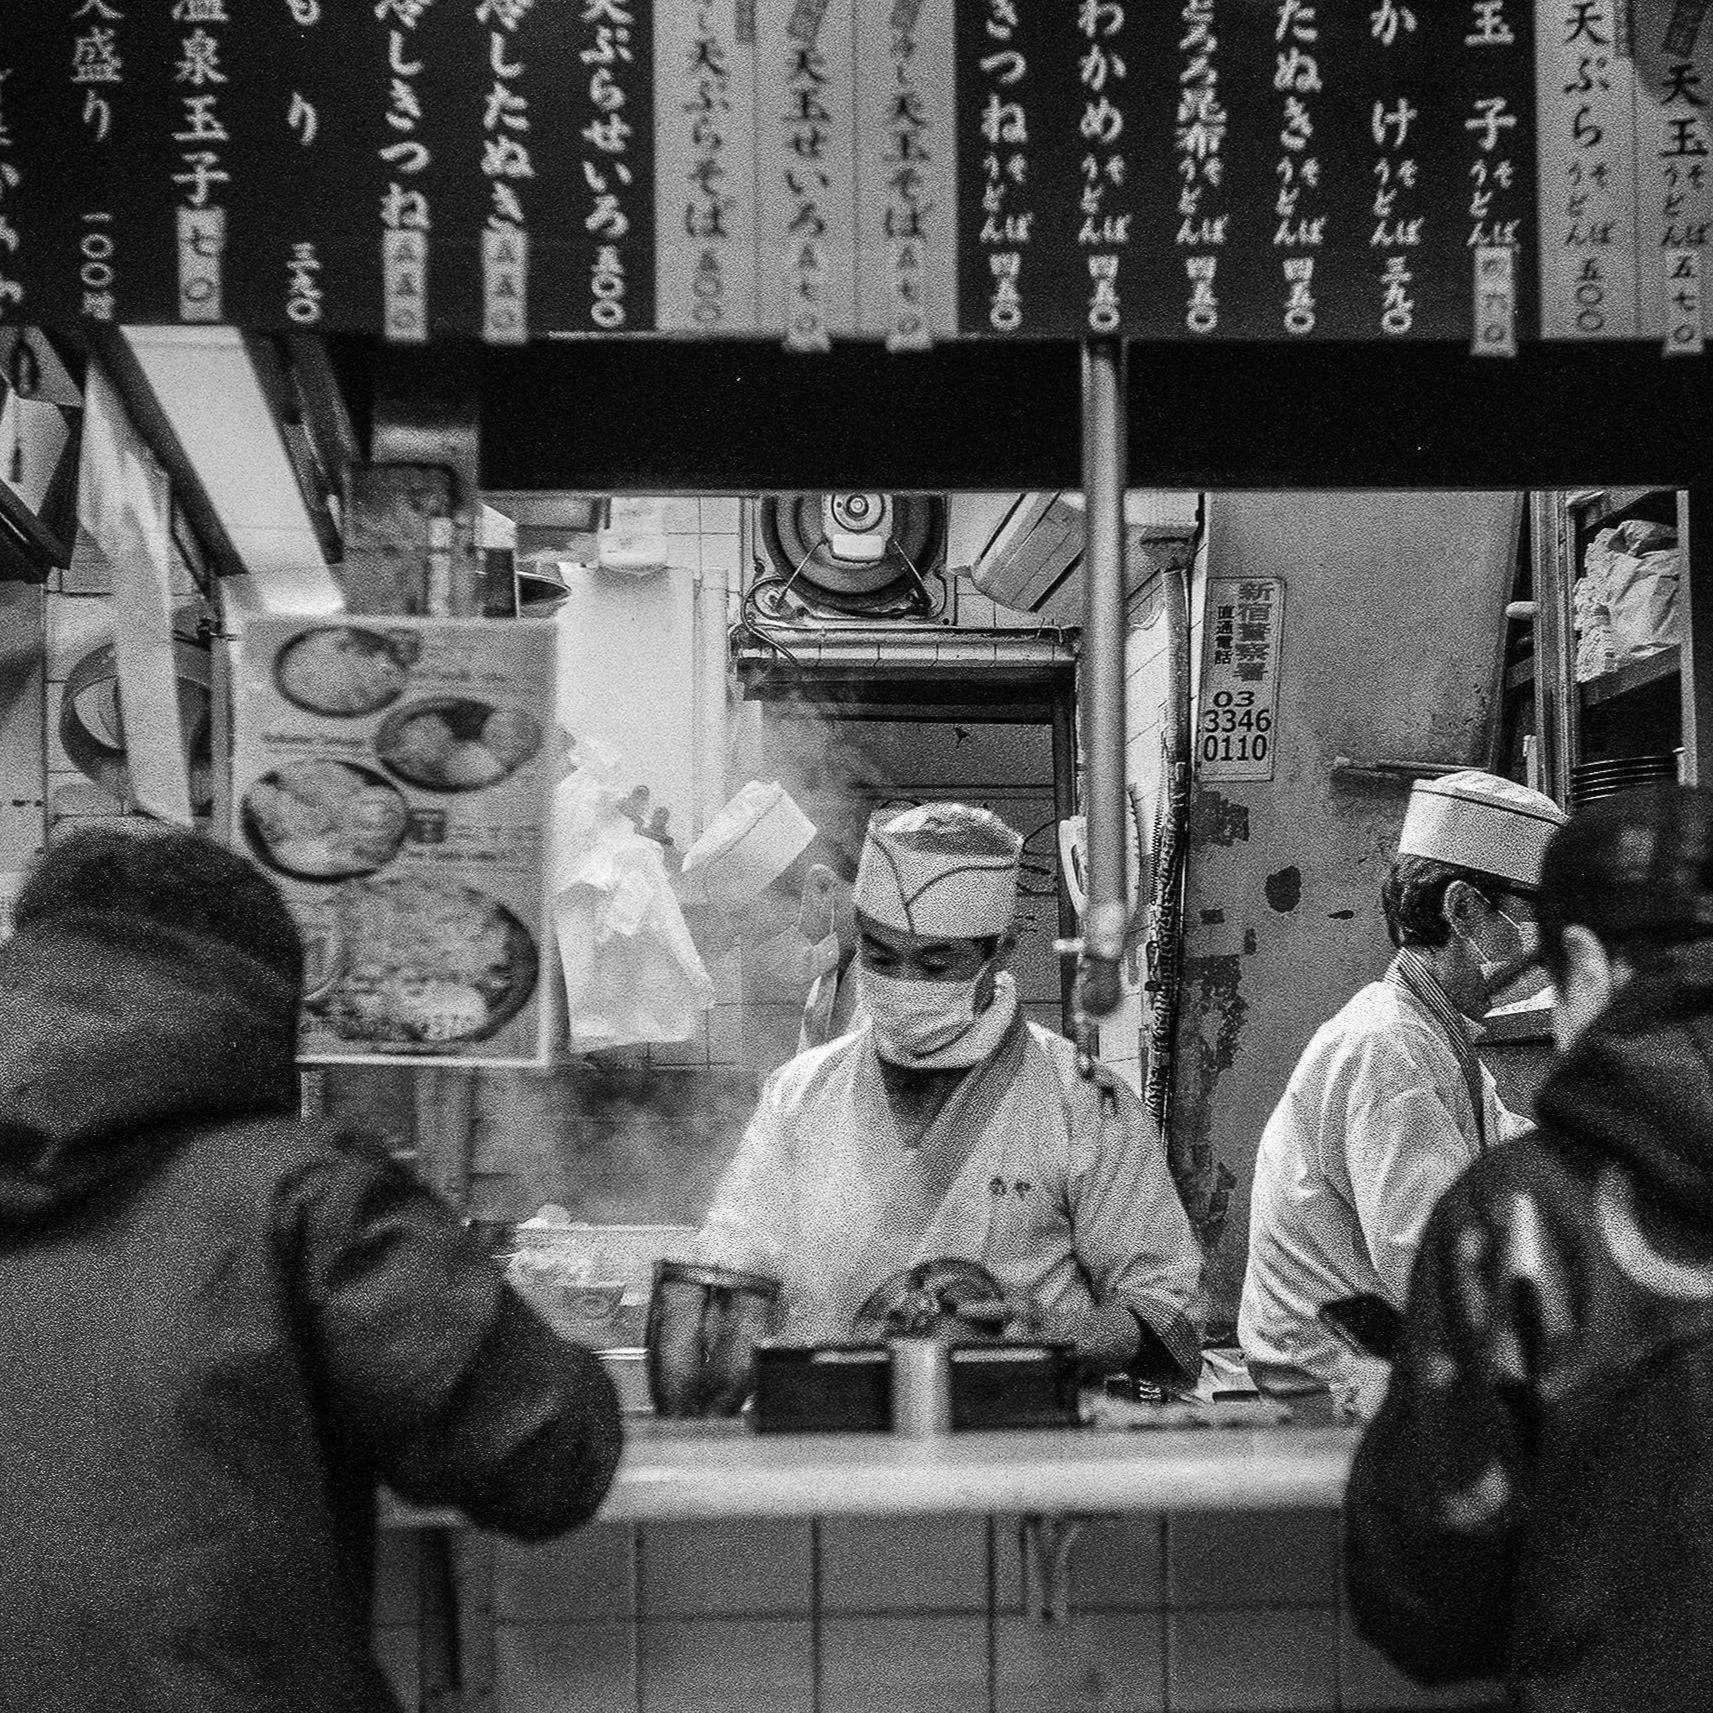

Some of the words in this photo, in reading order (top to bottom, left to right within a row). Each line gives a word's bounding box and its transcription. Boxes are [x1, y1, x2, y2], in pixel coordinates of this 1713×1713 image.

[1371, 0, 1417, 147] かけ
[1465, 0, 1516, 151] 玉子
[1560, 2, 1609, 147] 天ぷら
[1661, 63, 1709, 156] 天玉
[1205, 709, 1272, 733] 3346
[1213, 691, 1255, 707] 03
[1204, 734, 1268, 761] 0110
